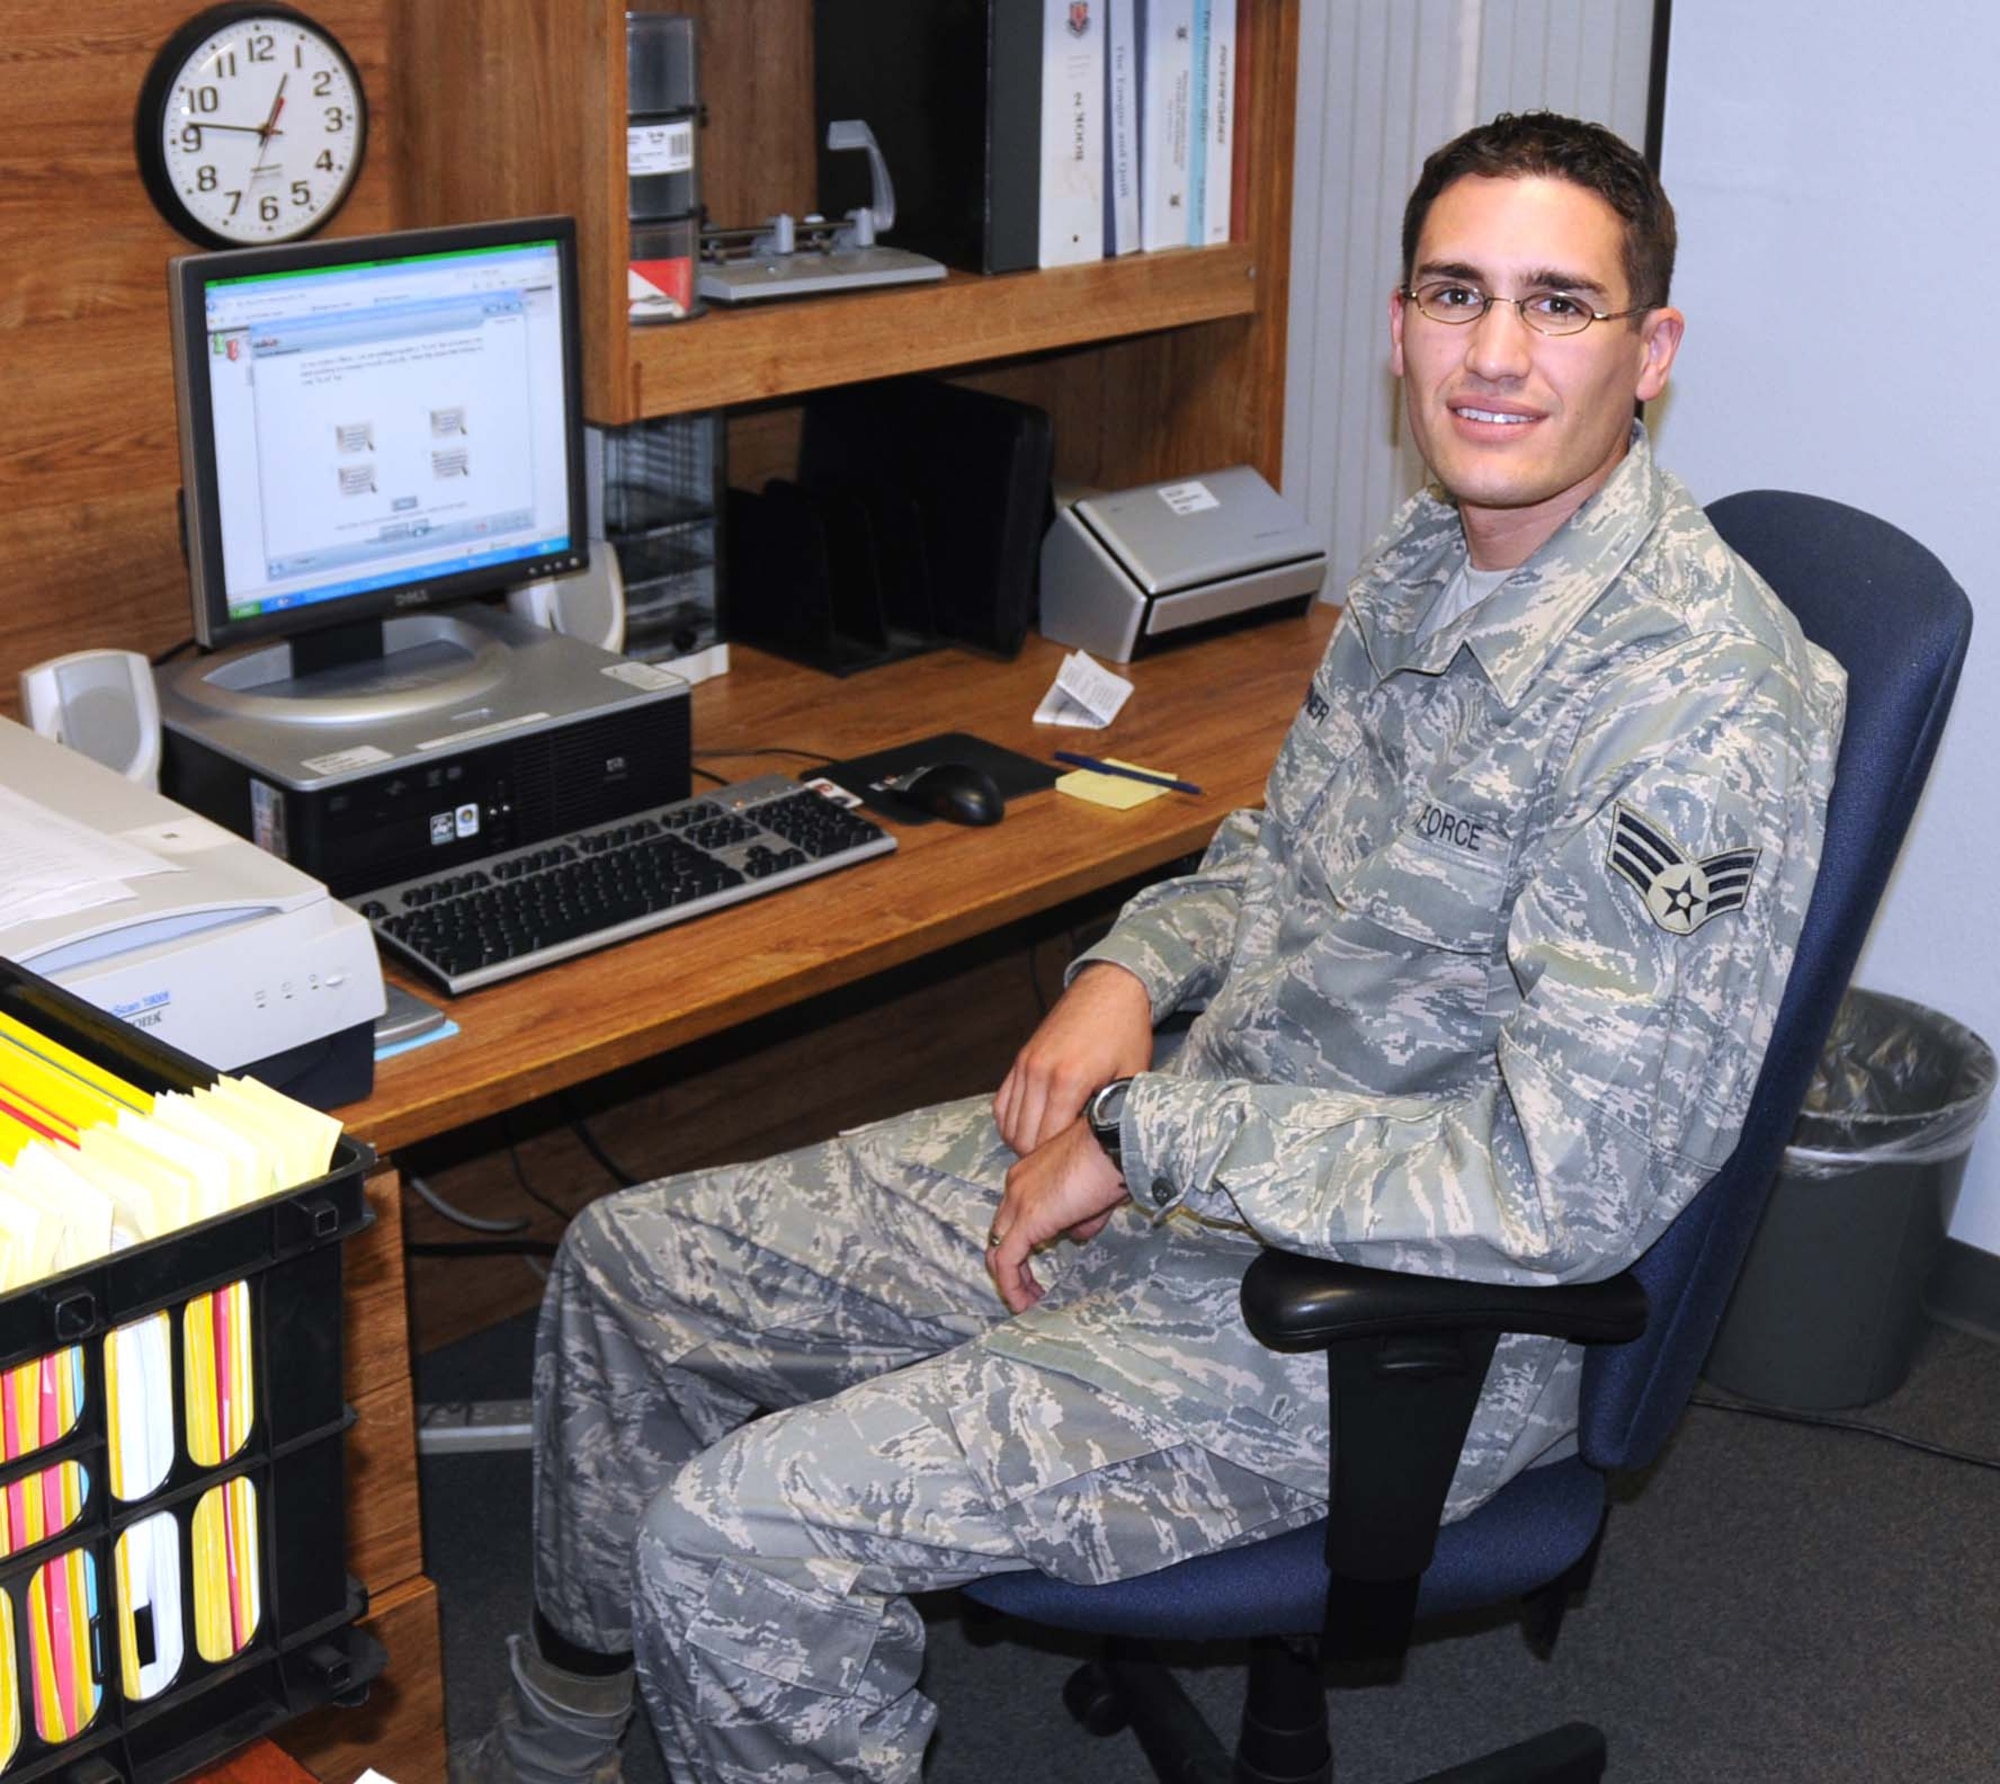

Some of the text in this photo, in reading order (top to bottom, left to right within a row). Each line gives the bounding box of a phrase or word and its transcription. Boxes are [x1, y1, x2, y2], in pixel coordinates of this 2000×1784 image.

[247, 35, 275, 63] 12
[294, 44, 302, 69] 1
[216, 52, 237, 78] 11
[312, 71, 332, 97] 2
[188, 86, 219, 113] 10
[1073, 91, 1083, 106] 2
[324, 107, 343, 133] 3
[181, 124, 202, 153] 9
[315, 150, 334, 172] 4
[196, 165, 217, 192] 8
[224, 190, 242, 216] 7
[291, 180, 311, 206] 5
[259, 196, 279, 222] 6
[133, 1010, 162, 1028] OTEK
